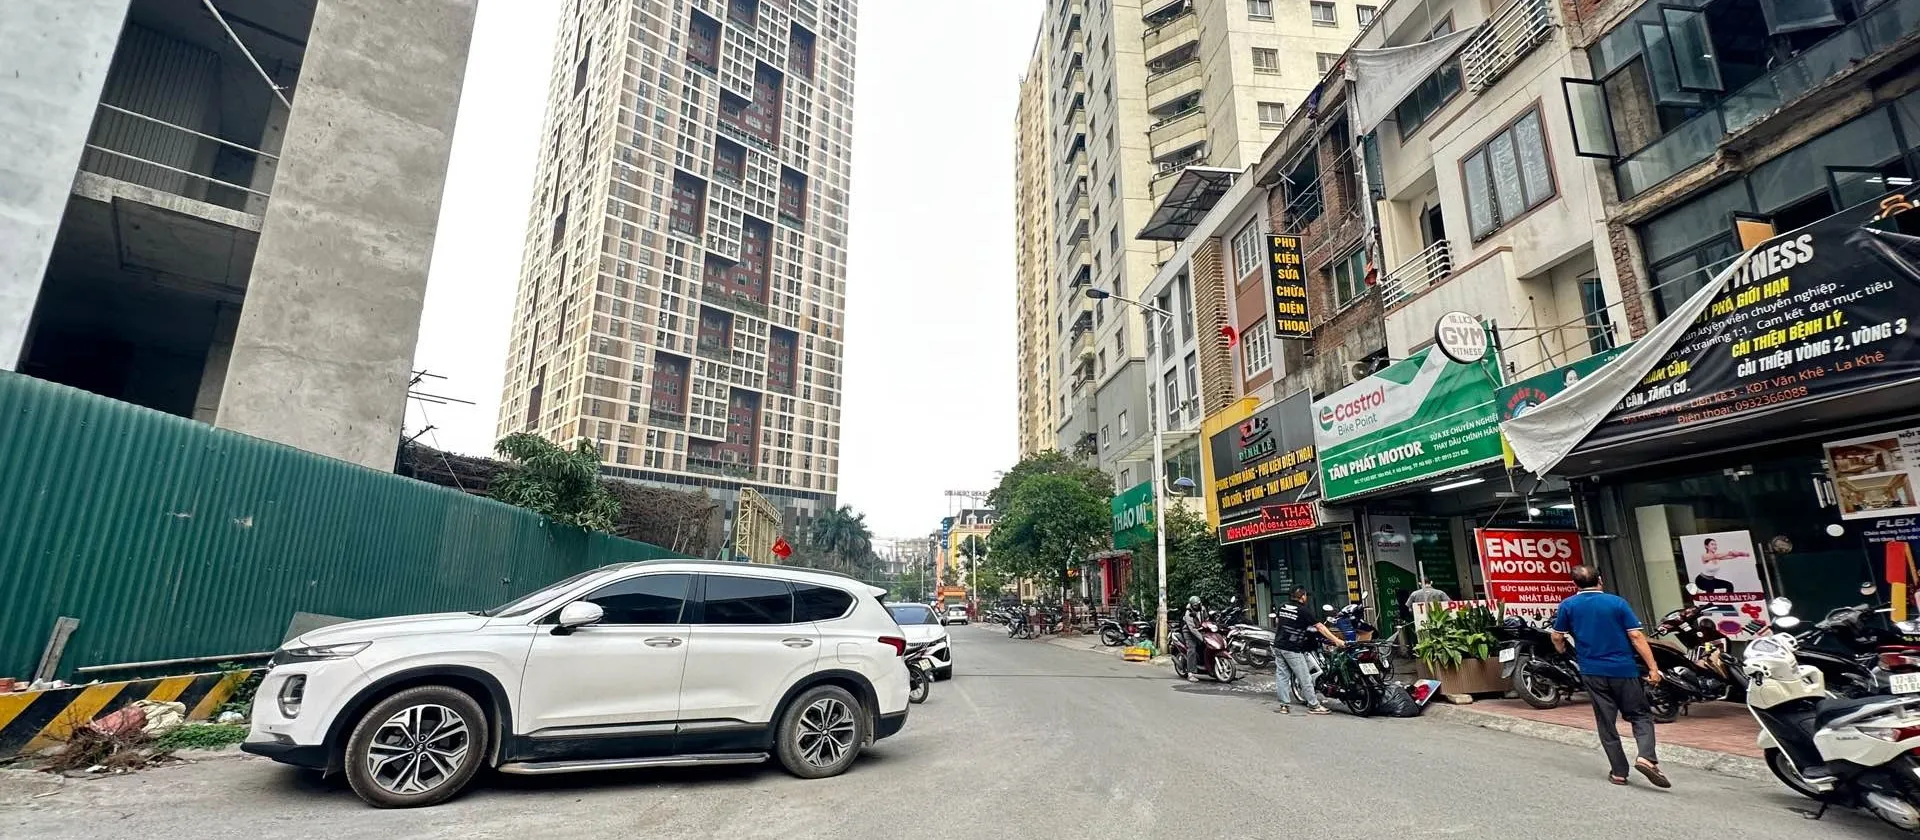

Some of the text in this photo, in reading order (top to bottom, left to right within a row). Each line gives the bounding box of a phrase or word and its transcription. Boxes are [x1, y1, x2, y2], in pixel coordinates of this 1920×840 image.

[1274, 237, 1296, 250] PHỤ
[1274, 251, 1300, 266] KIỆN
[1723, 233, 1815, 294] ITNESS
[1278, 264, 1300, 280] SỬA
[1276, 284, 1306, 298] CHỮA
[1736, 285, 1761, 308] GIỚI
[1763, 276, 1790, 299] HẠN
[1279, 300, 1305, 316] ĐIỆN
[1726, 313, 1749, 325] viên
[1751, 296, 1792, 318] chuyên
[1793, 281, 1837, 302] nghiệp
[1278, 319, 1311, 334] THOẠI
[1680, 346, 1691, 355] và
[1692, 333, 1732, 352] training
[1733, 327, 1752, 338] 1:1.
[1756, 316, 1783, 330] Cam
[1785, 308, 1804, 322] kết
[1809, 299, 1831, 314] đạt
[1833, 290, 1863, 306] mục
[1864, 280, 1894, 296] tiêu
[1442, 327, 1486, 346] GYM
[1732, 309, 1849, 359] CẢI THIỆN BỆNH LÝ.
[1452, 347, 1483, 356] FITNESS
[1738, 360, 1757, 378] CẢI
[1759, 349, 1793, 372] THIỆN
[1796, 339, 1831, 362] VÒNG
[1852, 321, 1892, 347] VÒNG
[1895, 317, 1907, 335] 3
[1729, 389, 1737, 399] 3
[1746, 380, 1769, 395] KĐT
[1771, 374, 1797, 389] Văn
[1798, 366, 1824, 381] Khê
[1836, 360, 1853, 373] La
[1855, 351, 1885, 368] Khê
[1335, 385, 1386, 422] Castrol
[1735, 386, 1809, 411] 0932366088
[1337, 412, 1378, 436] Bike Point
[1442, 430, 1451, 439] XE
[1450, 421, 1475, 434] CHUYÊN
[1433, 442, 1448, 452] THAY
[1462, 430, 1483, 443] CHÍNH
[1328, 440, 1425, 481] TÂN PHÁT MOTOR
[1113, 503, 1135, 532] THẢO
[1285, 519, 1298, 527] 123
[1876, 517, 1916, 529] FLEX
[1485, 537, 1572, 558] ENEOS
[1490, 560, 1548, 573] MOTOR
